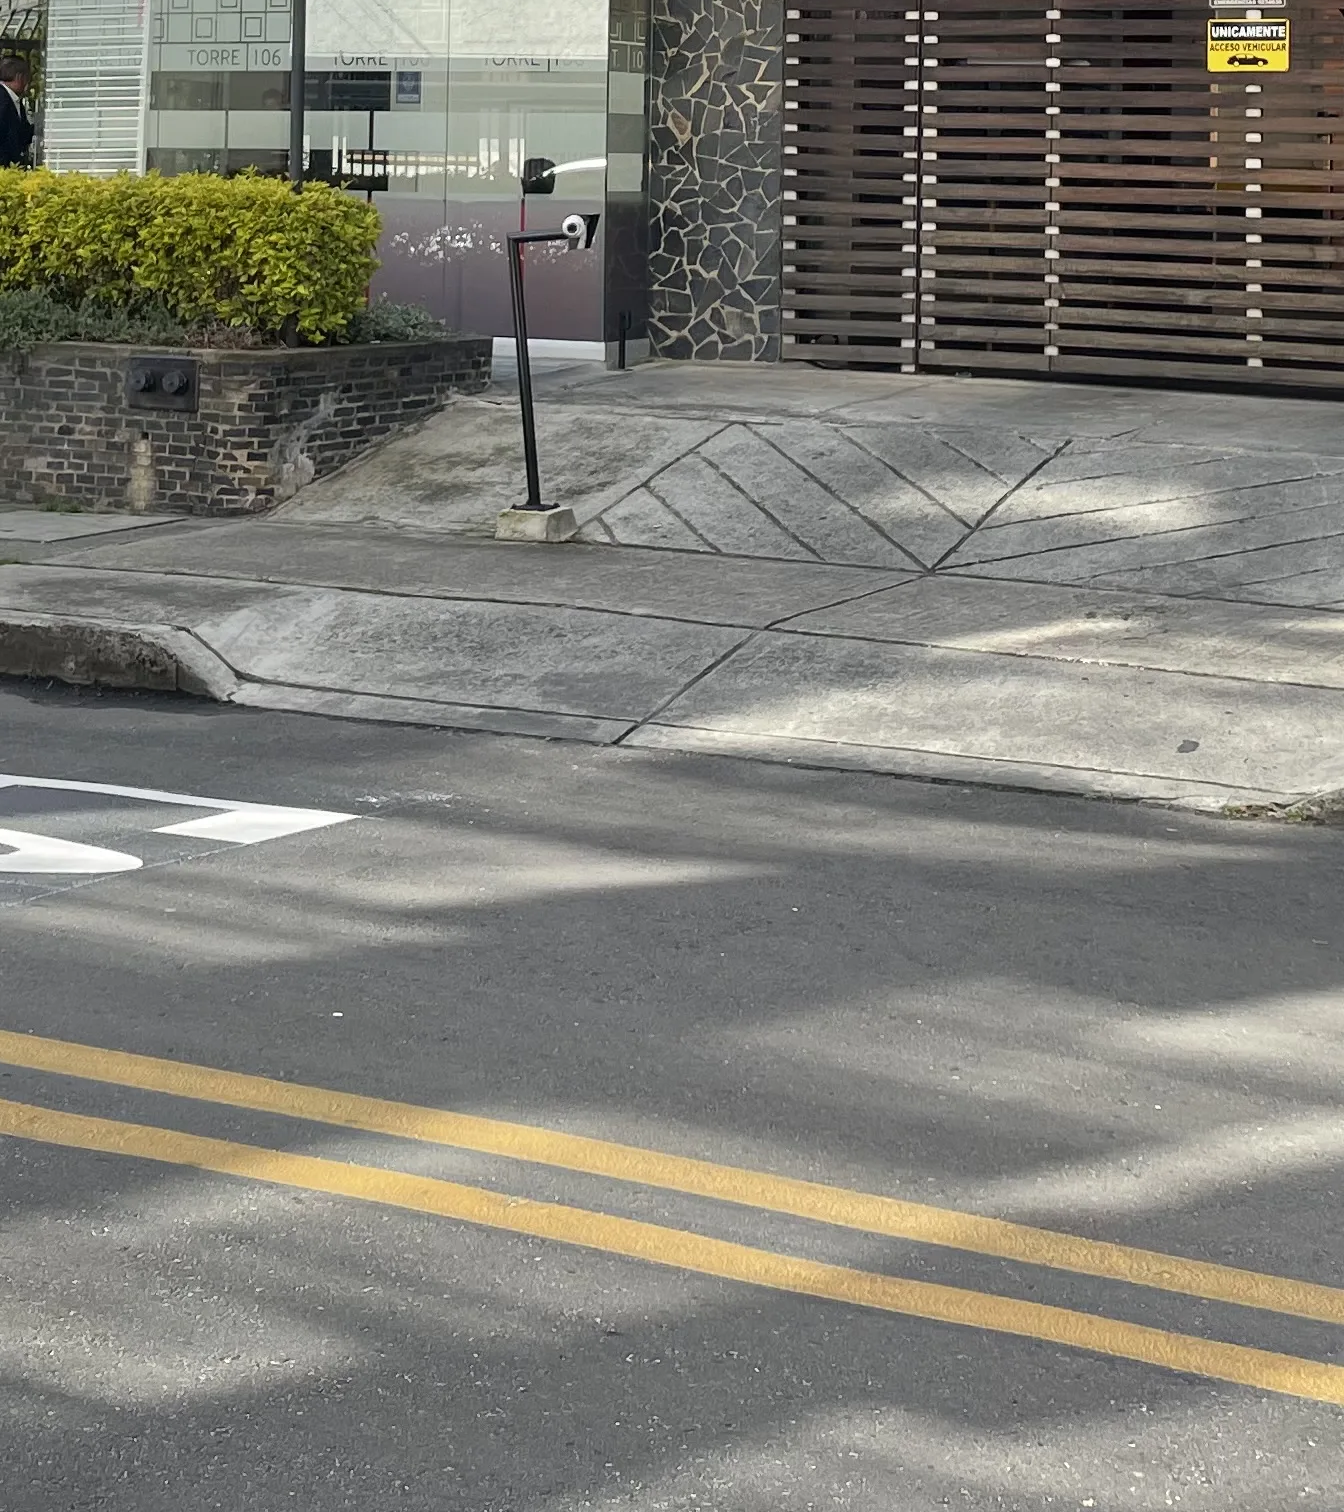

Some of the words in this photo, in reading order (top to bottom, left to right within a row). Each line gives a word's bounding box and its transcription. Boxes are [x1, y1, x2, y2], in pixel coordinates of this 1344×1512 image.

[1211, 25, 1286, 38] UNICAMENTE
[1209, 43, 1240, 52] ACCESO
[1242, 42, 1287, 52] VEHICULAR
[187, 48, 241, 66] TORRE
[254, 48, 282, 66] 106
[632, 50, 644, 69] 10
